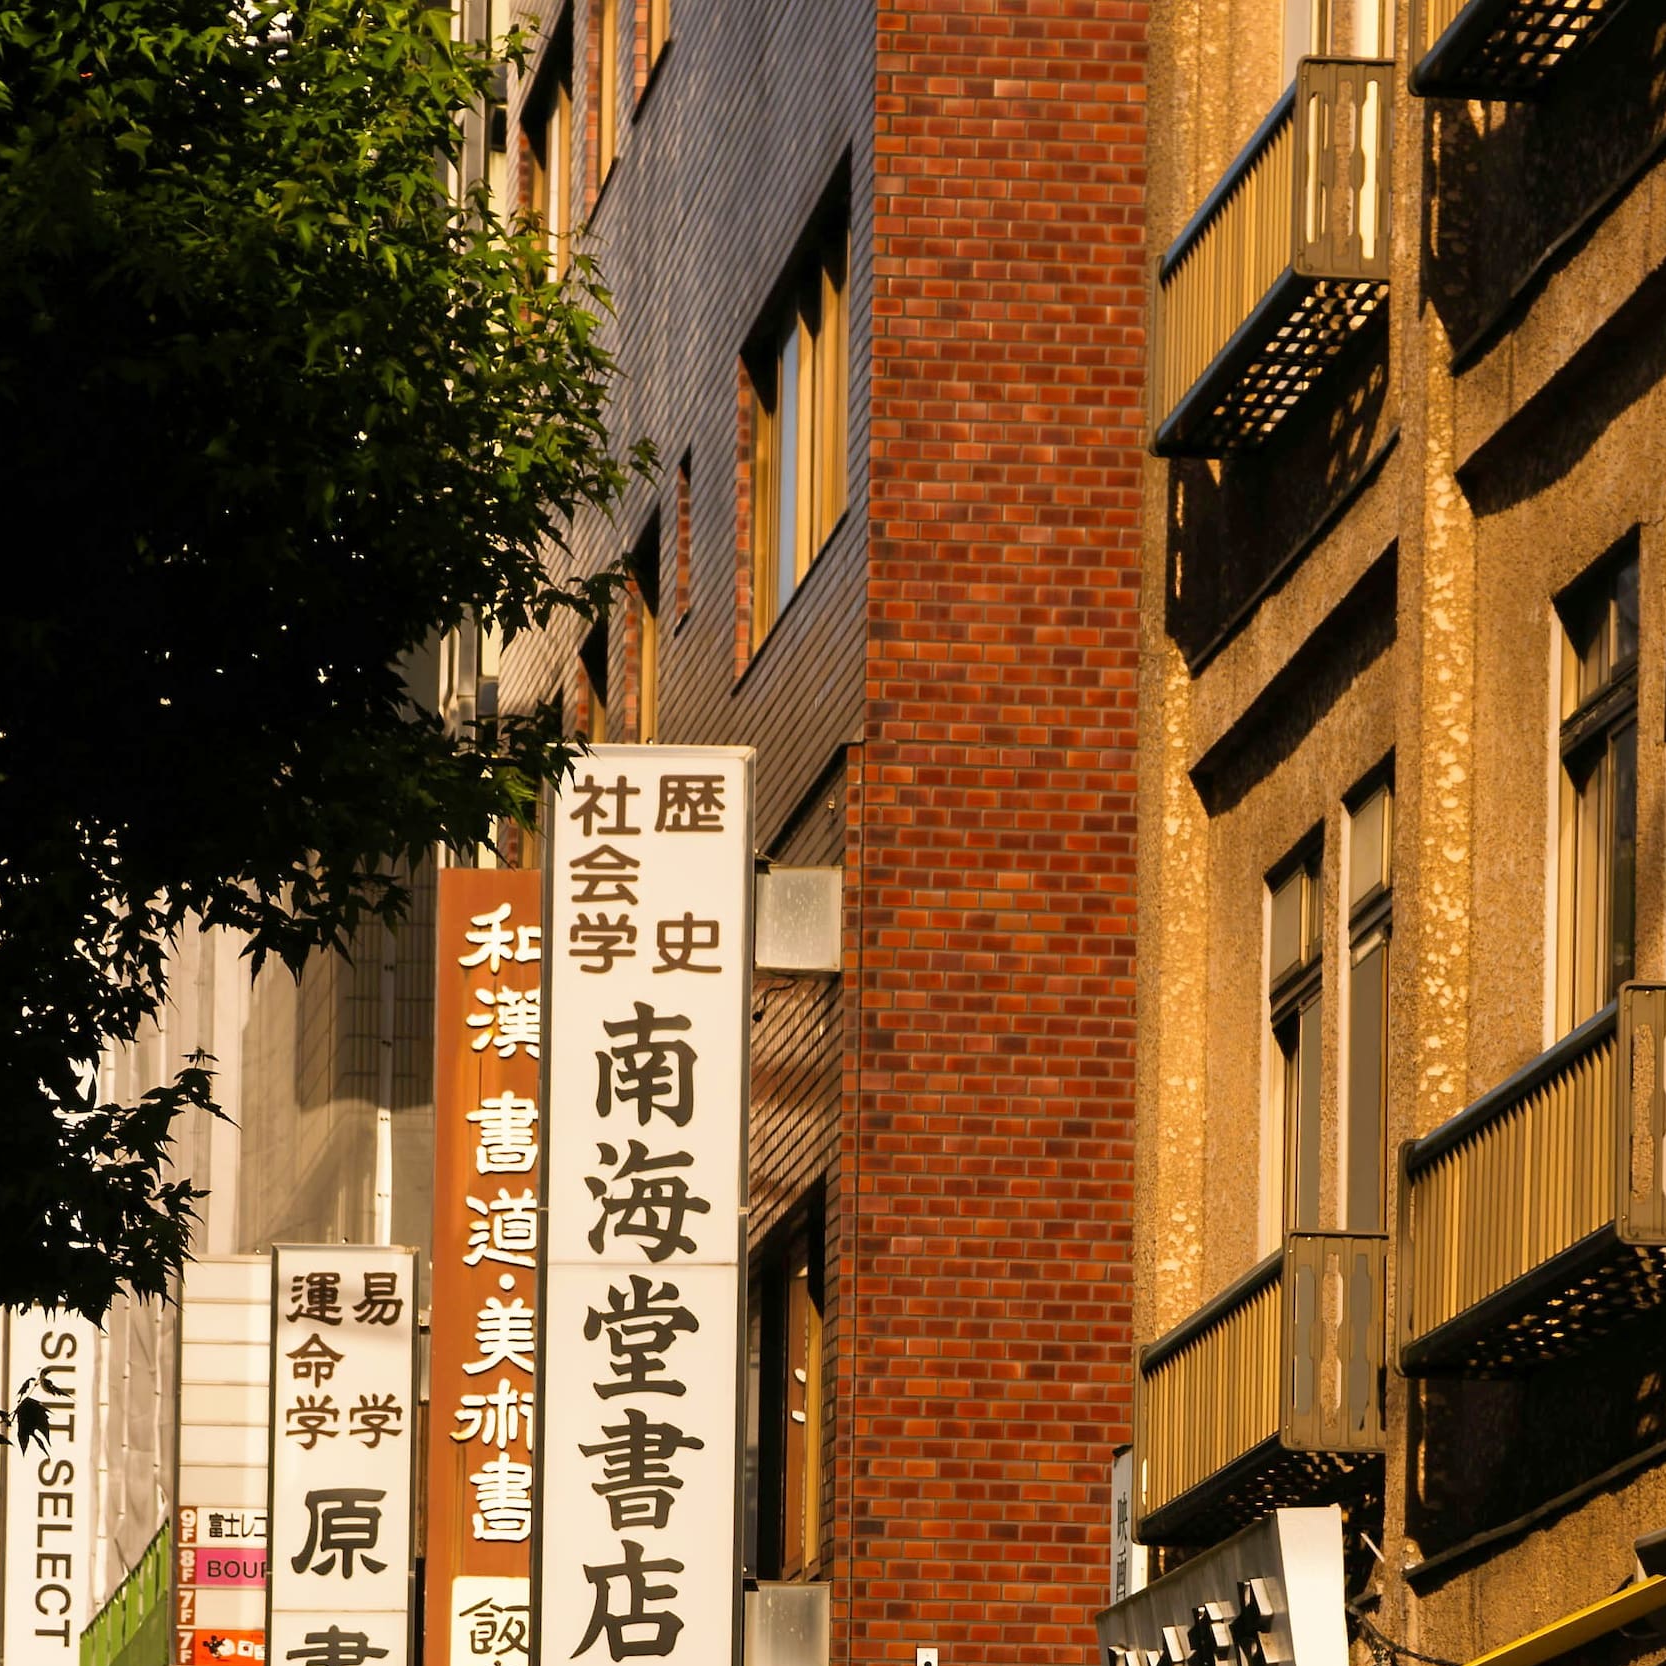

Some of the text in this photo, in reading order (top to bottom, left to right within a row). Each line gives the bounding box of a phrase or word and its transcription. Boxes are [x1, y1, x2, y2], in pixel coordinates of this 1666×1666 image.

[569, 774, 642, 974] 社会学
[653, 774, 725, 974] 歴史
[285, 1272, 345, 1450] 運命学
[349, 1272, 403, 1450] 易学
[569, 1001, 711, 1663] 南海堂書店
[35, 1331, 77, 1648] SUIT SELECT
[180, 1509, 196, 1542] 9F
[180, 1550, 195, 1582] 8F
[179, 1590, 194, 1622] 7F
[179, 1632, 193, 1664] 7F
